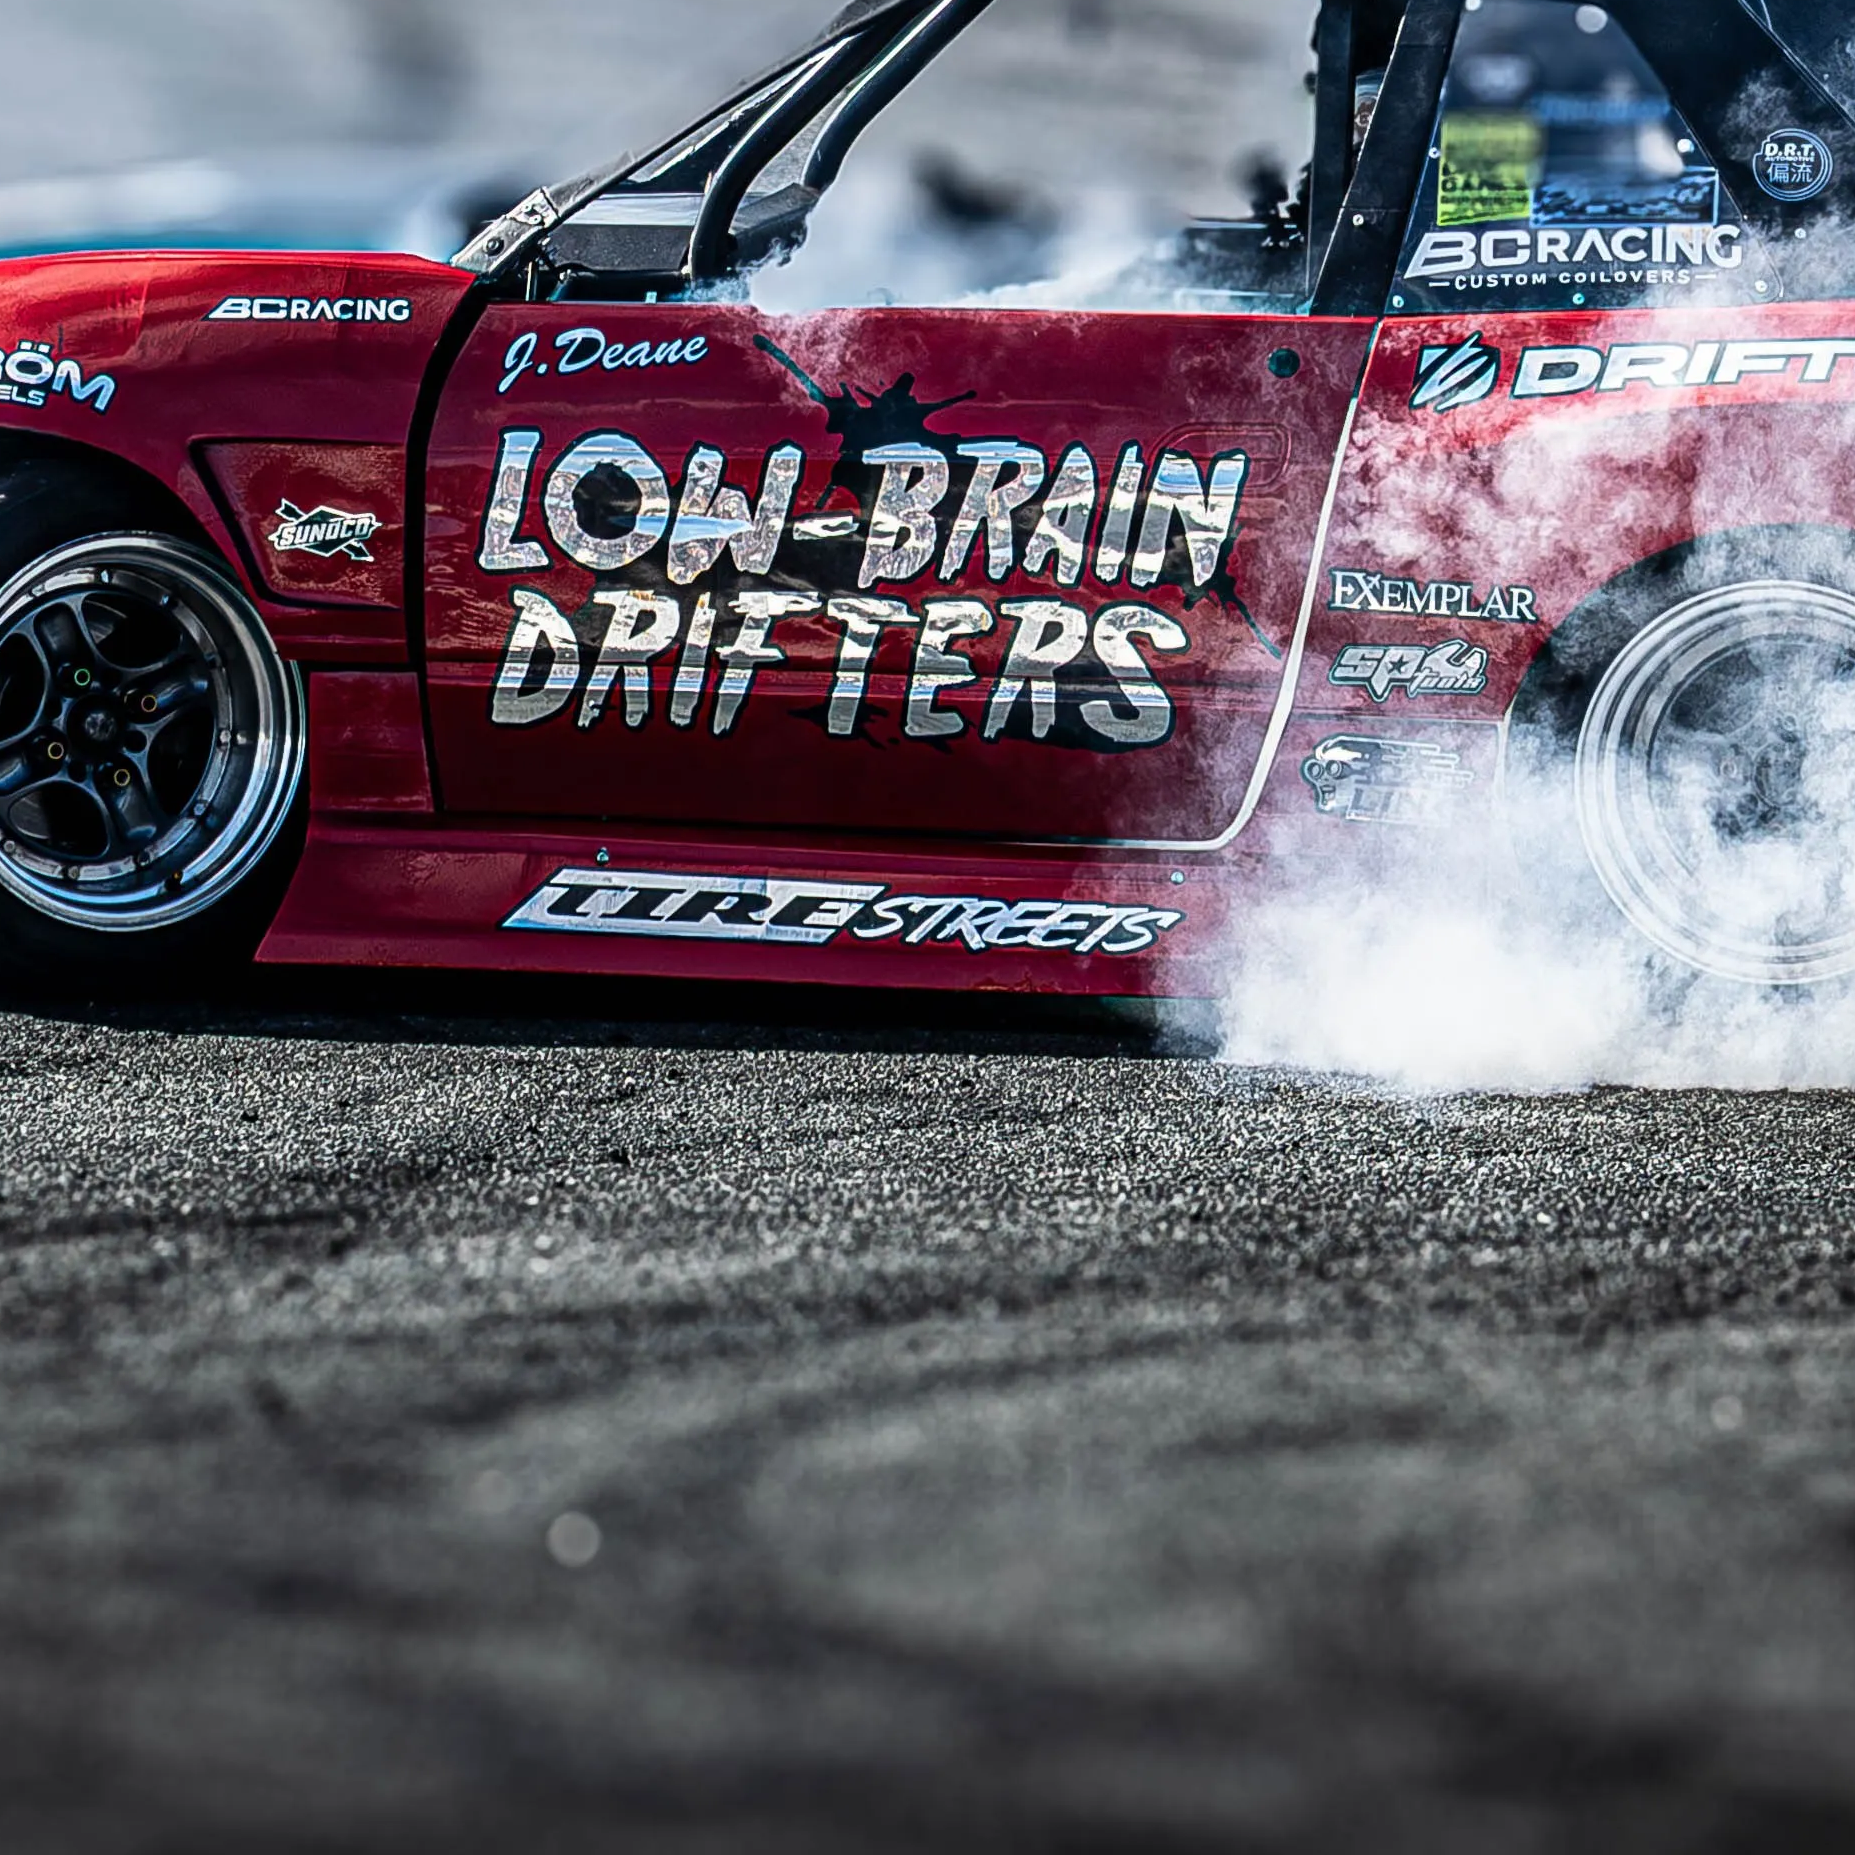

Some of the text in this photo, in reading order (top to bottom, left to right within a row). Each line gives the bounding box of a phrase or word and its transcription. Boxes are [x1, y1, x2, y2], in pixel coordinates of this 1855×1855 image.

[1765, 143, 1816, 156] D.R.T.
[1767, 163, 1813, 183] 偏流
[1455, 269, 1691, 290] CUSTOM COILOVERS
[280, 518, 371, 546] SUNOCO
[1331, 571, 1537, 621] EXEMPLAR
[489, 589, 1187, 744] DRIFTERS
